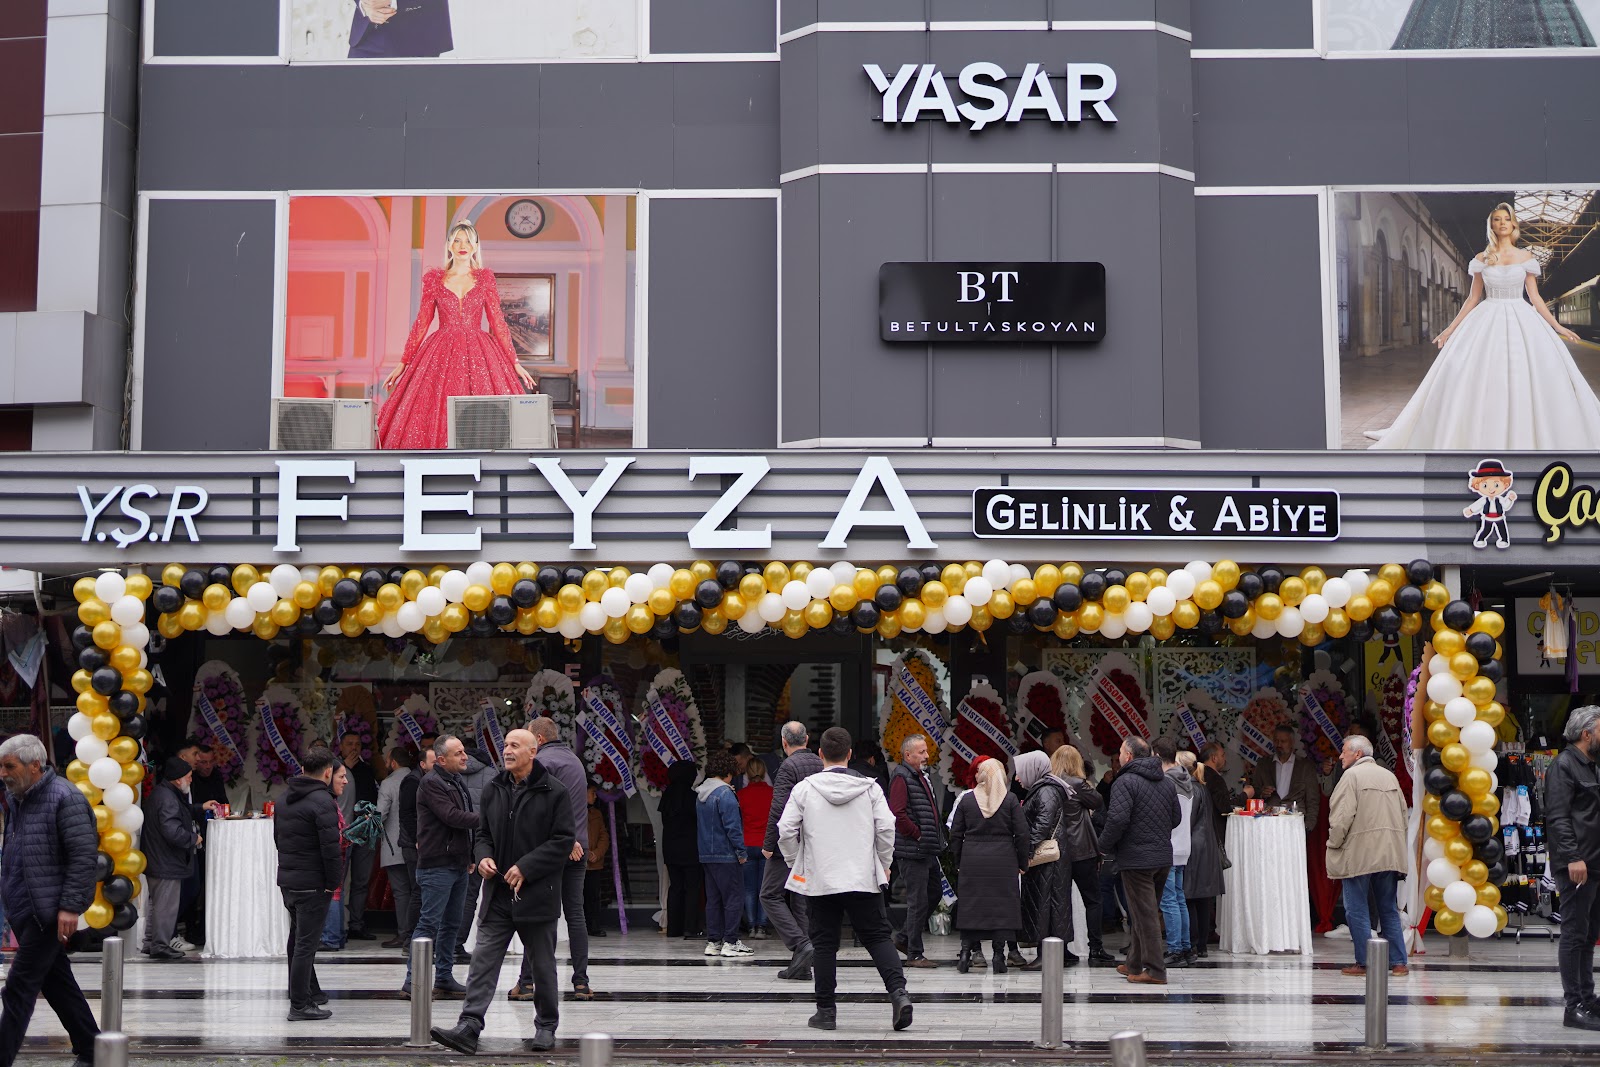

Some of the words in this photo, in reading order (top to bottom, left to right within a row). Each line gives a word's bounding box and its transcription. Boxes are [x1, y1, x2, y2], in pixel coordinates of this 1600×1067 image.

[862, 61, 1118, 130] YAŞAR
[956, 271, 1019, 302] BT
[77, 484, 209, 549] Y.Ş.R
[273, 455, 939, 552] FEYZA
[1168, 494, 1197, 532] &
[1536, 465, 1600, 542] Ço
[261, 704, 283, 748] BROMALL
[933, 713, 948, 729] TOP
[1092, 692, 1121, 727] MUSTAFA
[1313, 709, 1336, 736] MARKA
[613, 724, 635, 757] YÖNET
[948, 734, 976, 762] Mura
[995, 732, 1017, 756] TOPTAN
[1379, 735, 1397, 772] DÜNYA
[613, 754, 633, 791] KURULU
